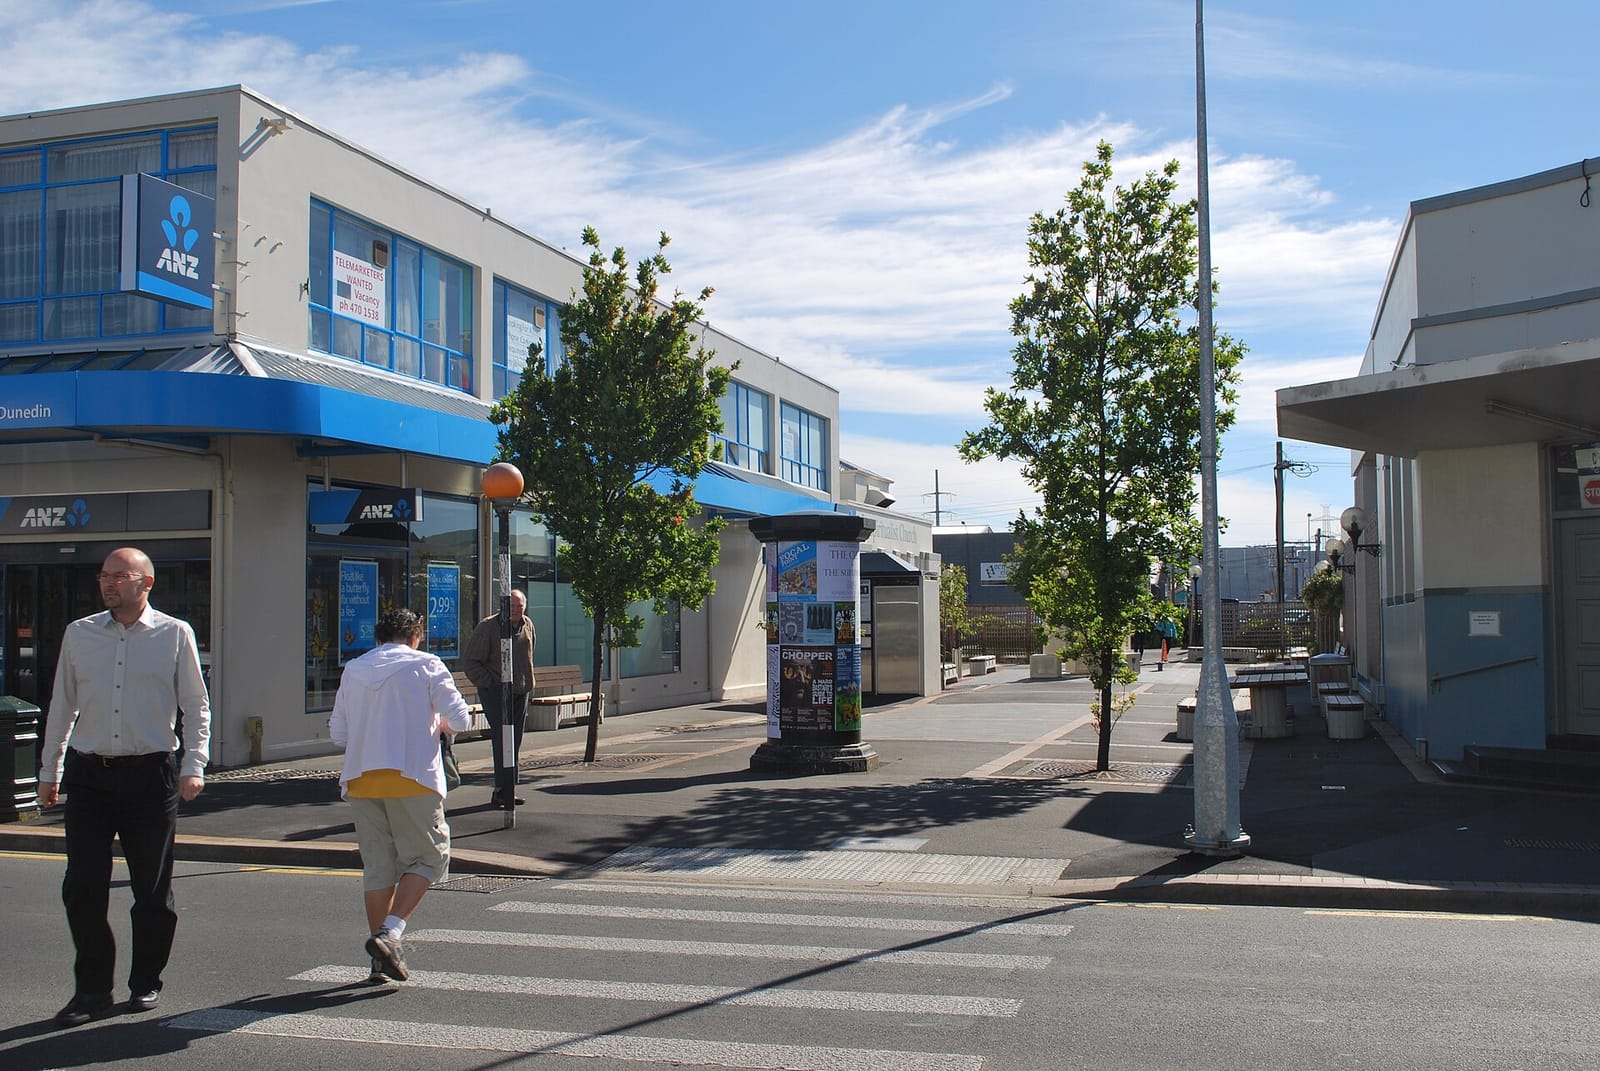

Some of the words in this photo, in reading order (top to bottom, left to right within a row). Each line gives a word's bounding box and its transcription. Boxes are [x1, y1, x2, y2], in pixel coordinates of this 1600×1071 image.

[156, 248, 199, 280] ANZ
[335, 256, 384, 281] TELEMARKETERS
[346, 274, 373, 291] WANTED
[354, 289, 380, 308] Vacancy
[339, 300, 349, 311] ph
[349, 302, 362, 314] 470
[364, 307, 379, 320] 1538
[0, 404, 51, 419] Dunedin
[20, 507, 66, 527] ANZ
[360, 504, 393, 519] ANZ
[779, 543, 810, 562] FOCAL
[830, 549, 848, 560] THE
[429, 596, 450, 618] 2.99
[782, 651, 833, 660] CHOPPER
[812, 696, 833, 705] LIFE
